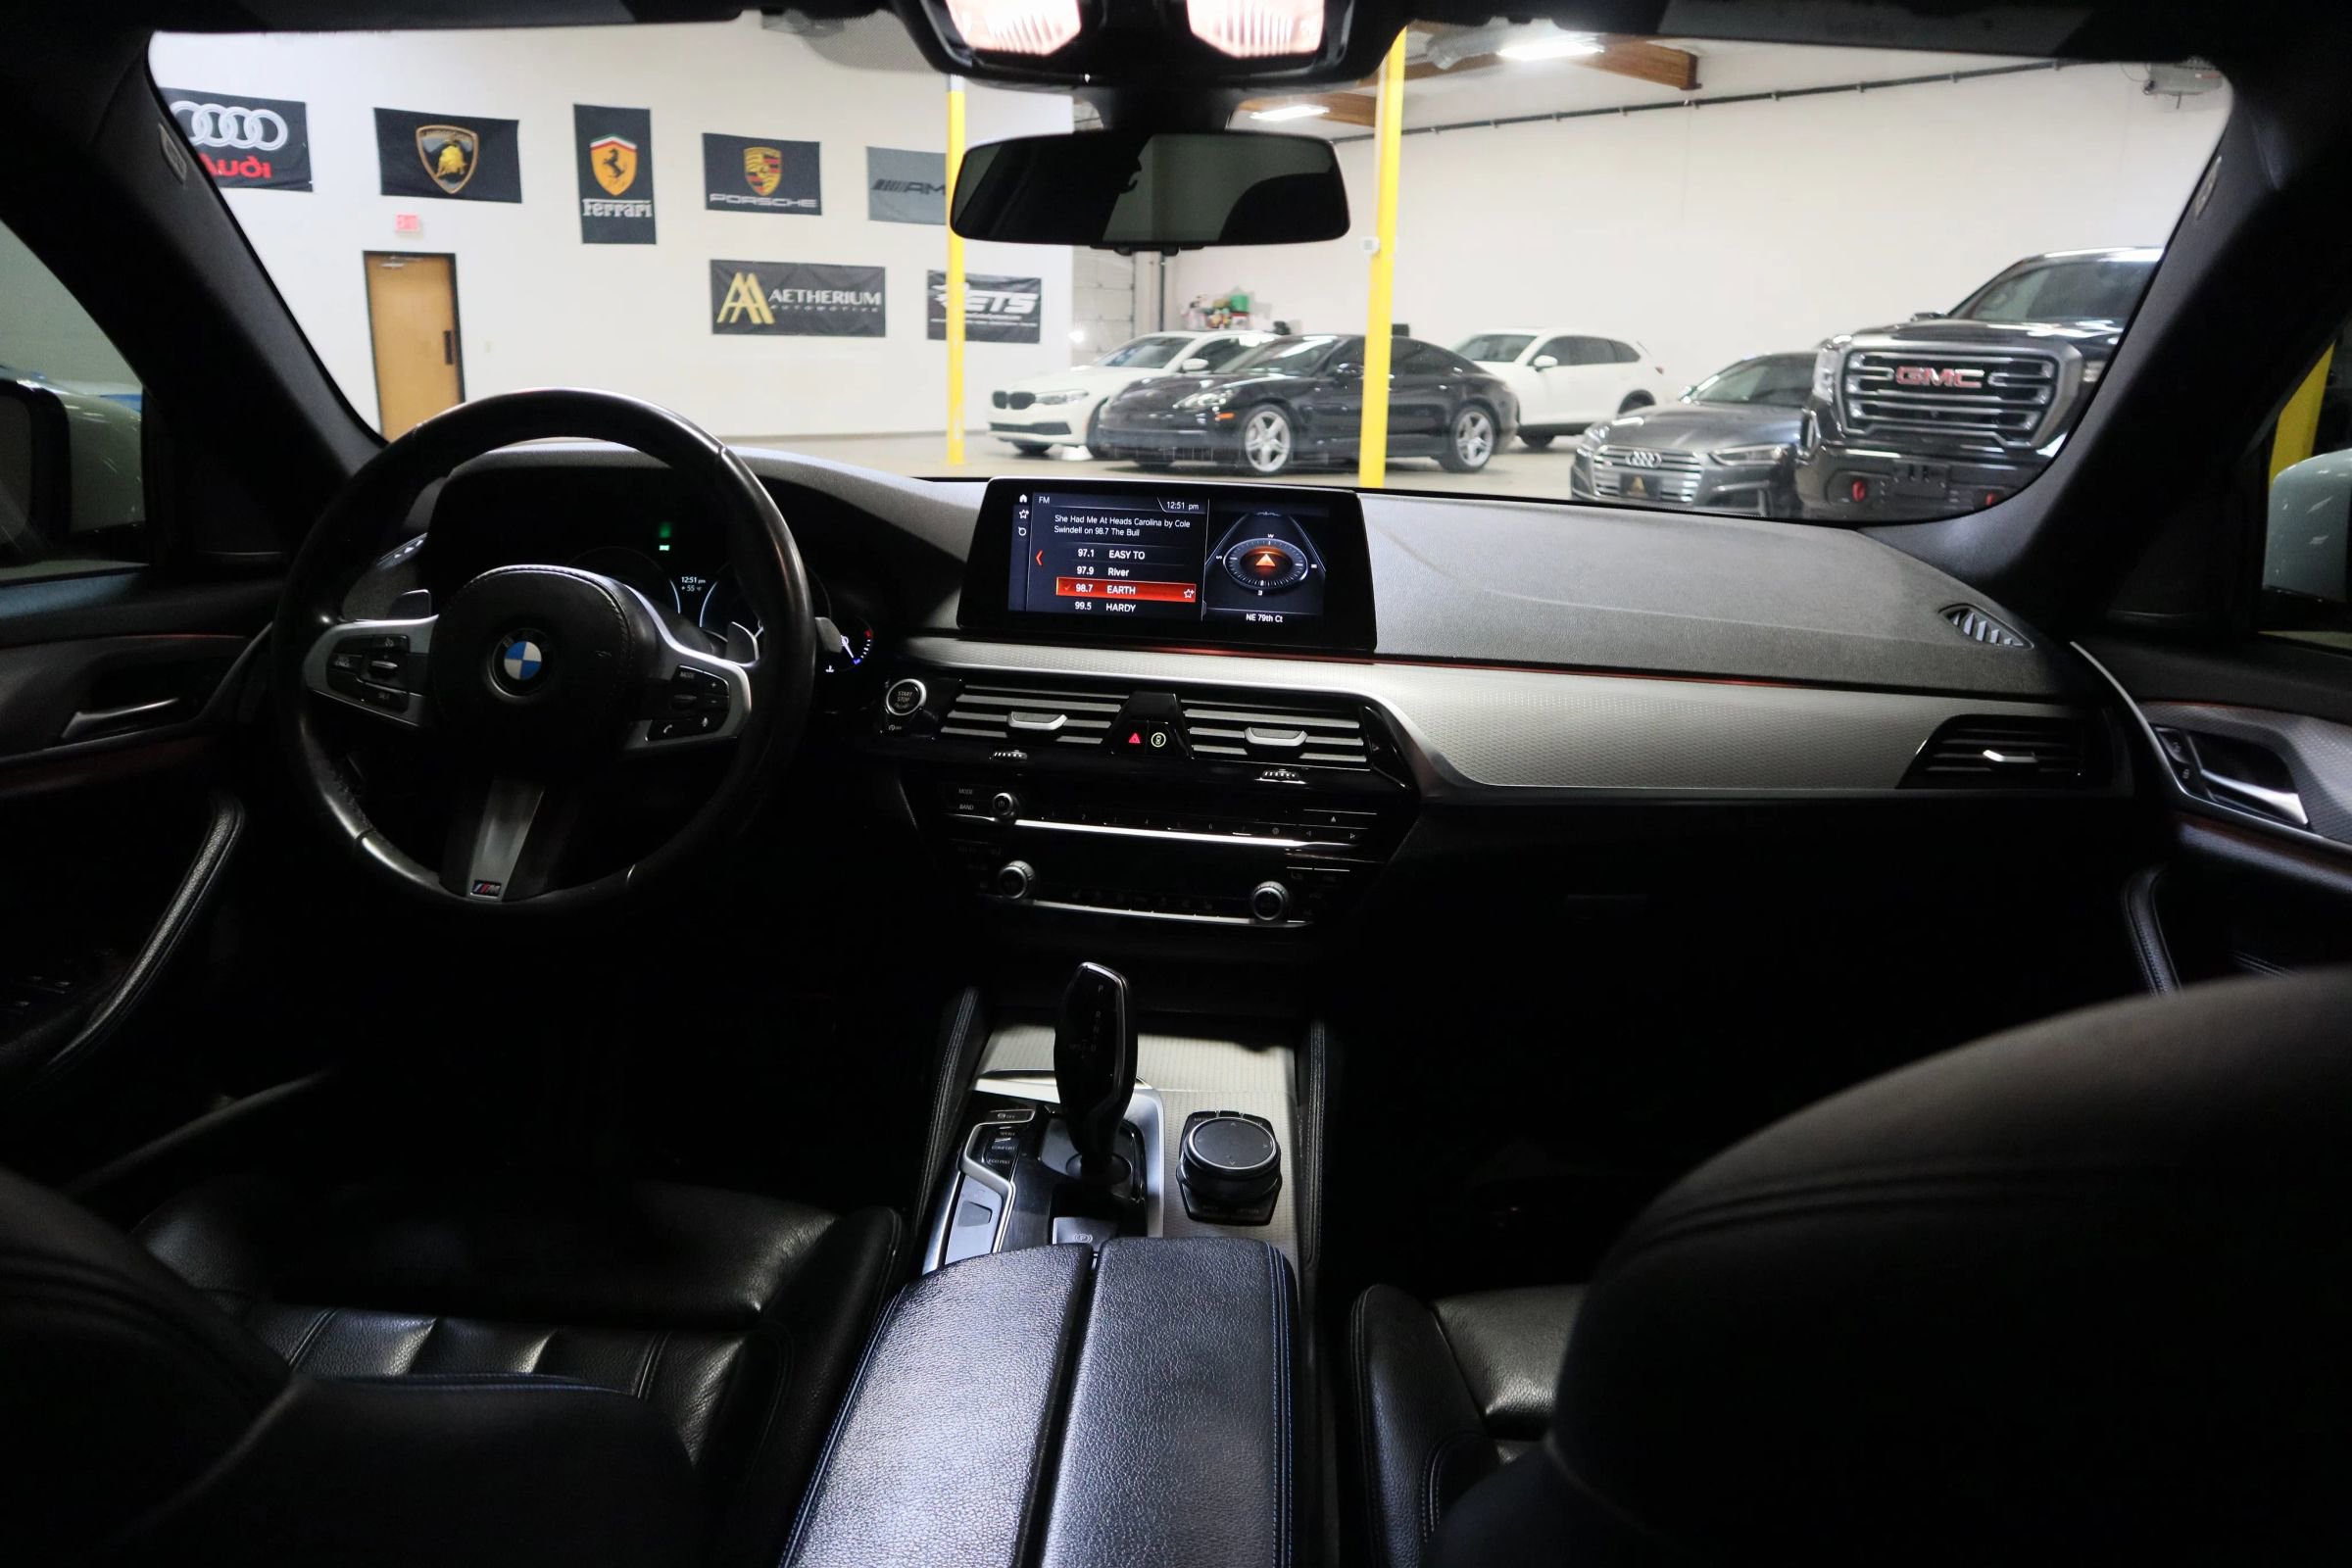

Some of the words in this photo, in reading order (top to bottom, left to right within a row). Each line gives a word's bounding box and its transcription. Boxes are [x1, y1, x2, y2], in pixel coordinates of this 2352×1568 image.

[710, 194, 817, 208] PORSCHE
[582, 198, 653, 218] Ferrari
[768, 288, 881, 306] AETHERIUM
[1895, 366, 1984, 388] GMC
[1078, 549, 1095, 558] 97.1
[1108, 550, 1131, 559] EASY
[1133, 551, 1145, 560] TO
[1108, 567, 1129, 576] River
[1106, 585, 1136, 595] EARTH
[1105, 604, 1136, 612] HARDY
